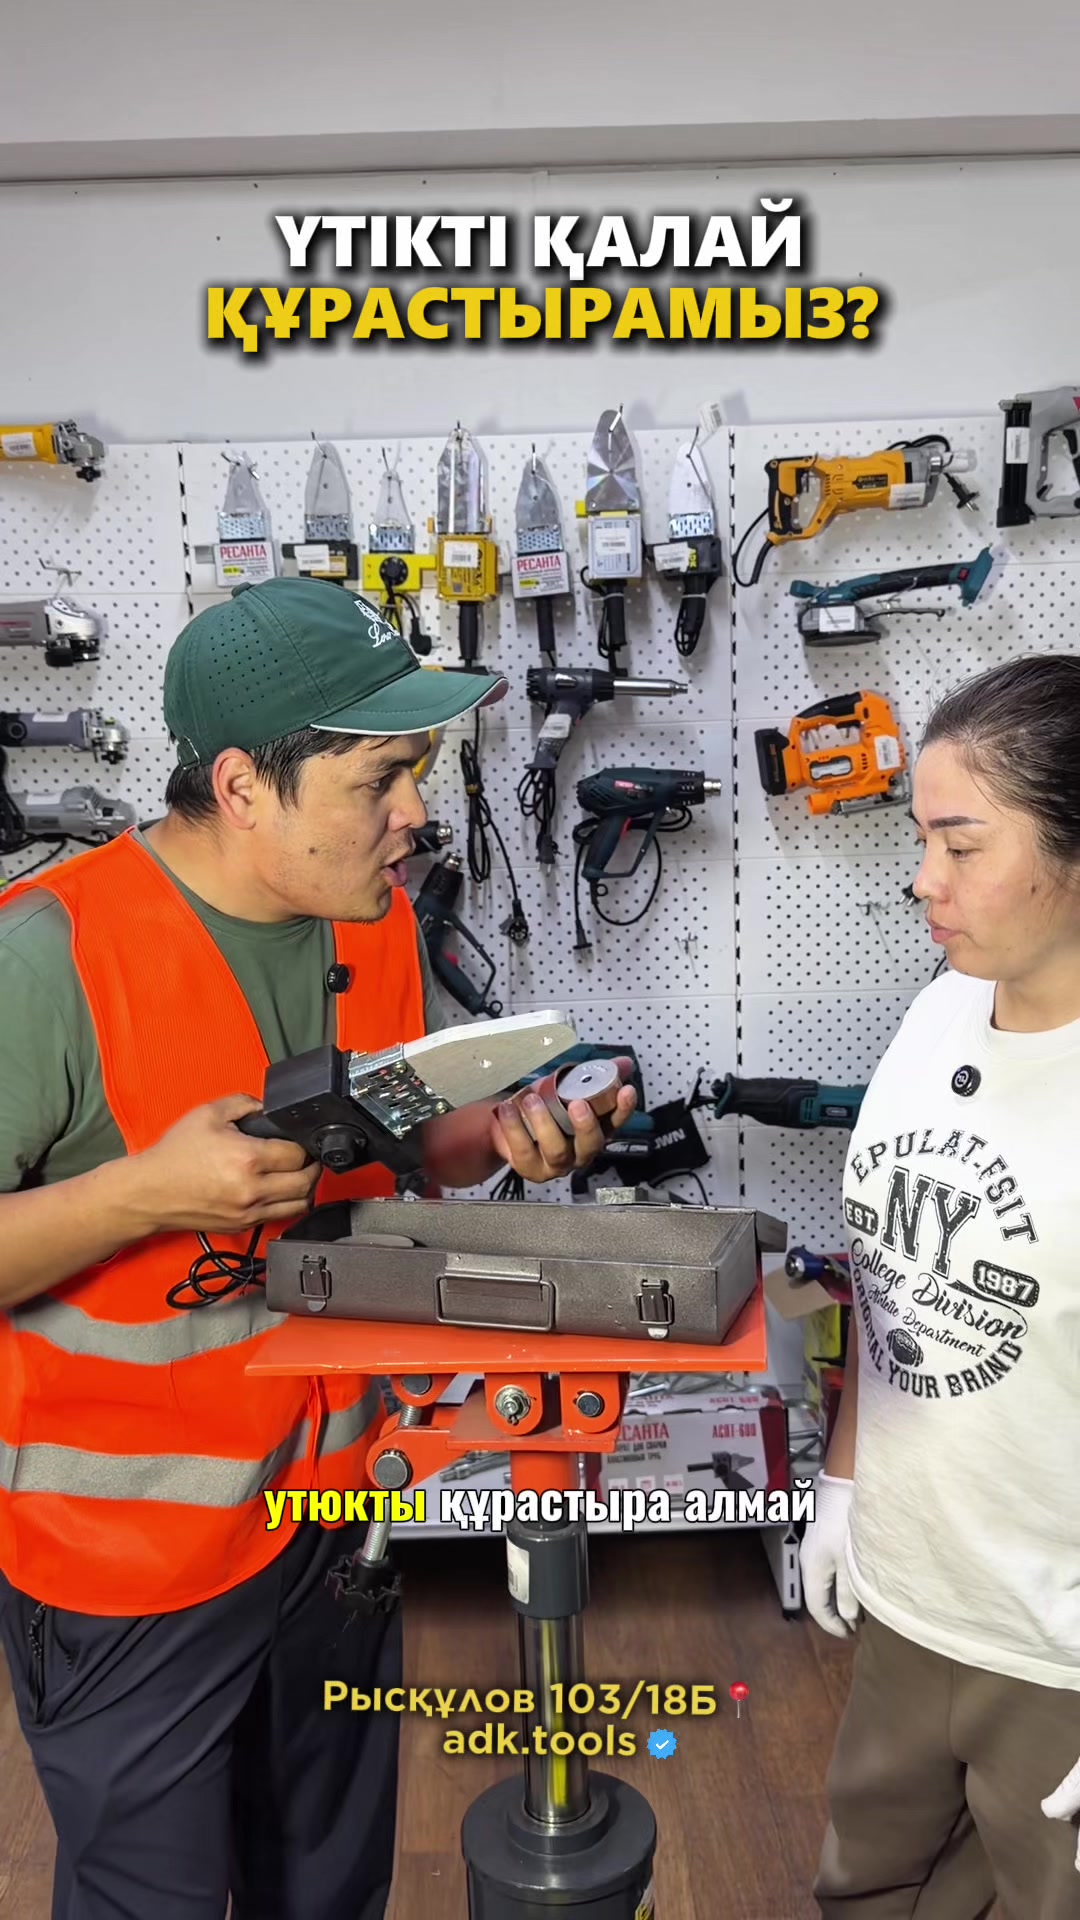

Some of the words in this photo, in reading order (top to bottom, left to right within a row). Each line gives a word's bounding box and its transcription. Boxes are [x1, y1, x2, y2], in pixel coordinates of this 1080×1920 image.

[220, 544, 267, 559] РЕСАНТА
[517, 555, 561, 571] РЕСАНТА
[845, 1202, 877, 1233] EST.
[880, 1165, 981, 1279] NY
[851, 1238, 906, 1294] College
[978, 1266, 1035, 1301] 1987
[912, 1273, 1028, 1339] Division
[902, 1307, 985, 1357] Department
[888, 1360, 940, 1398] YOUR
[945, 1340, 1023, 1397] BRAND
[618, 1422, 669, 1441] САНТА
